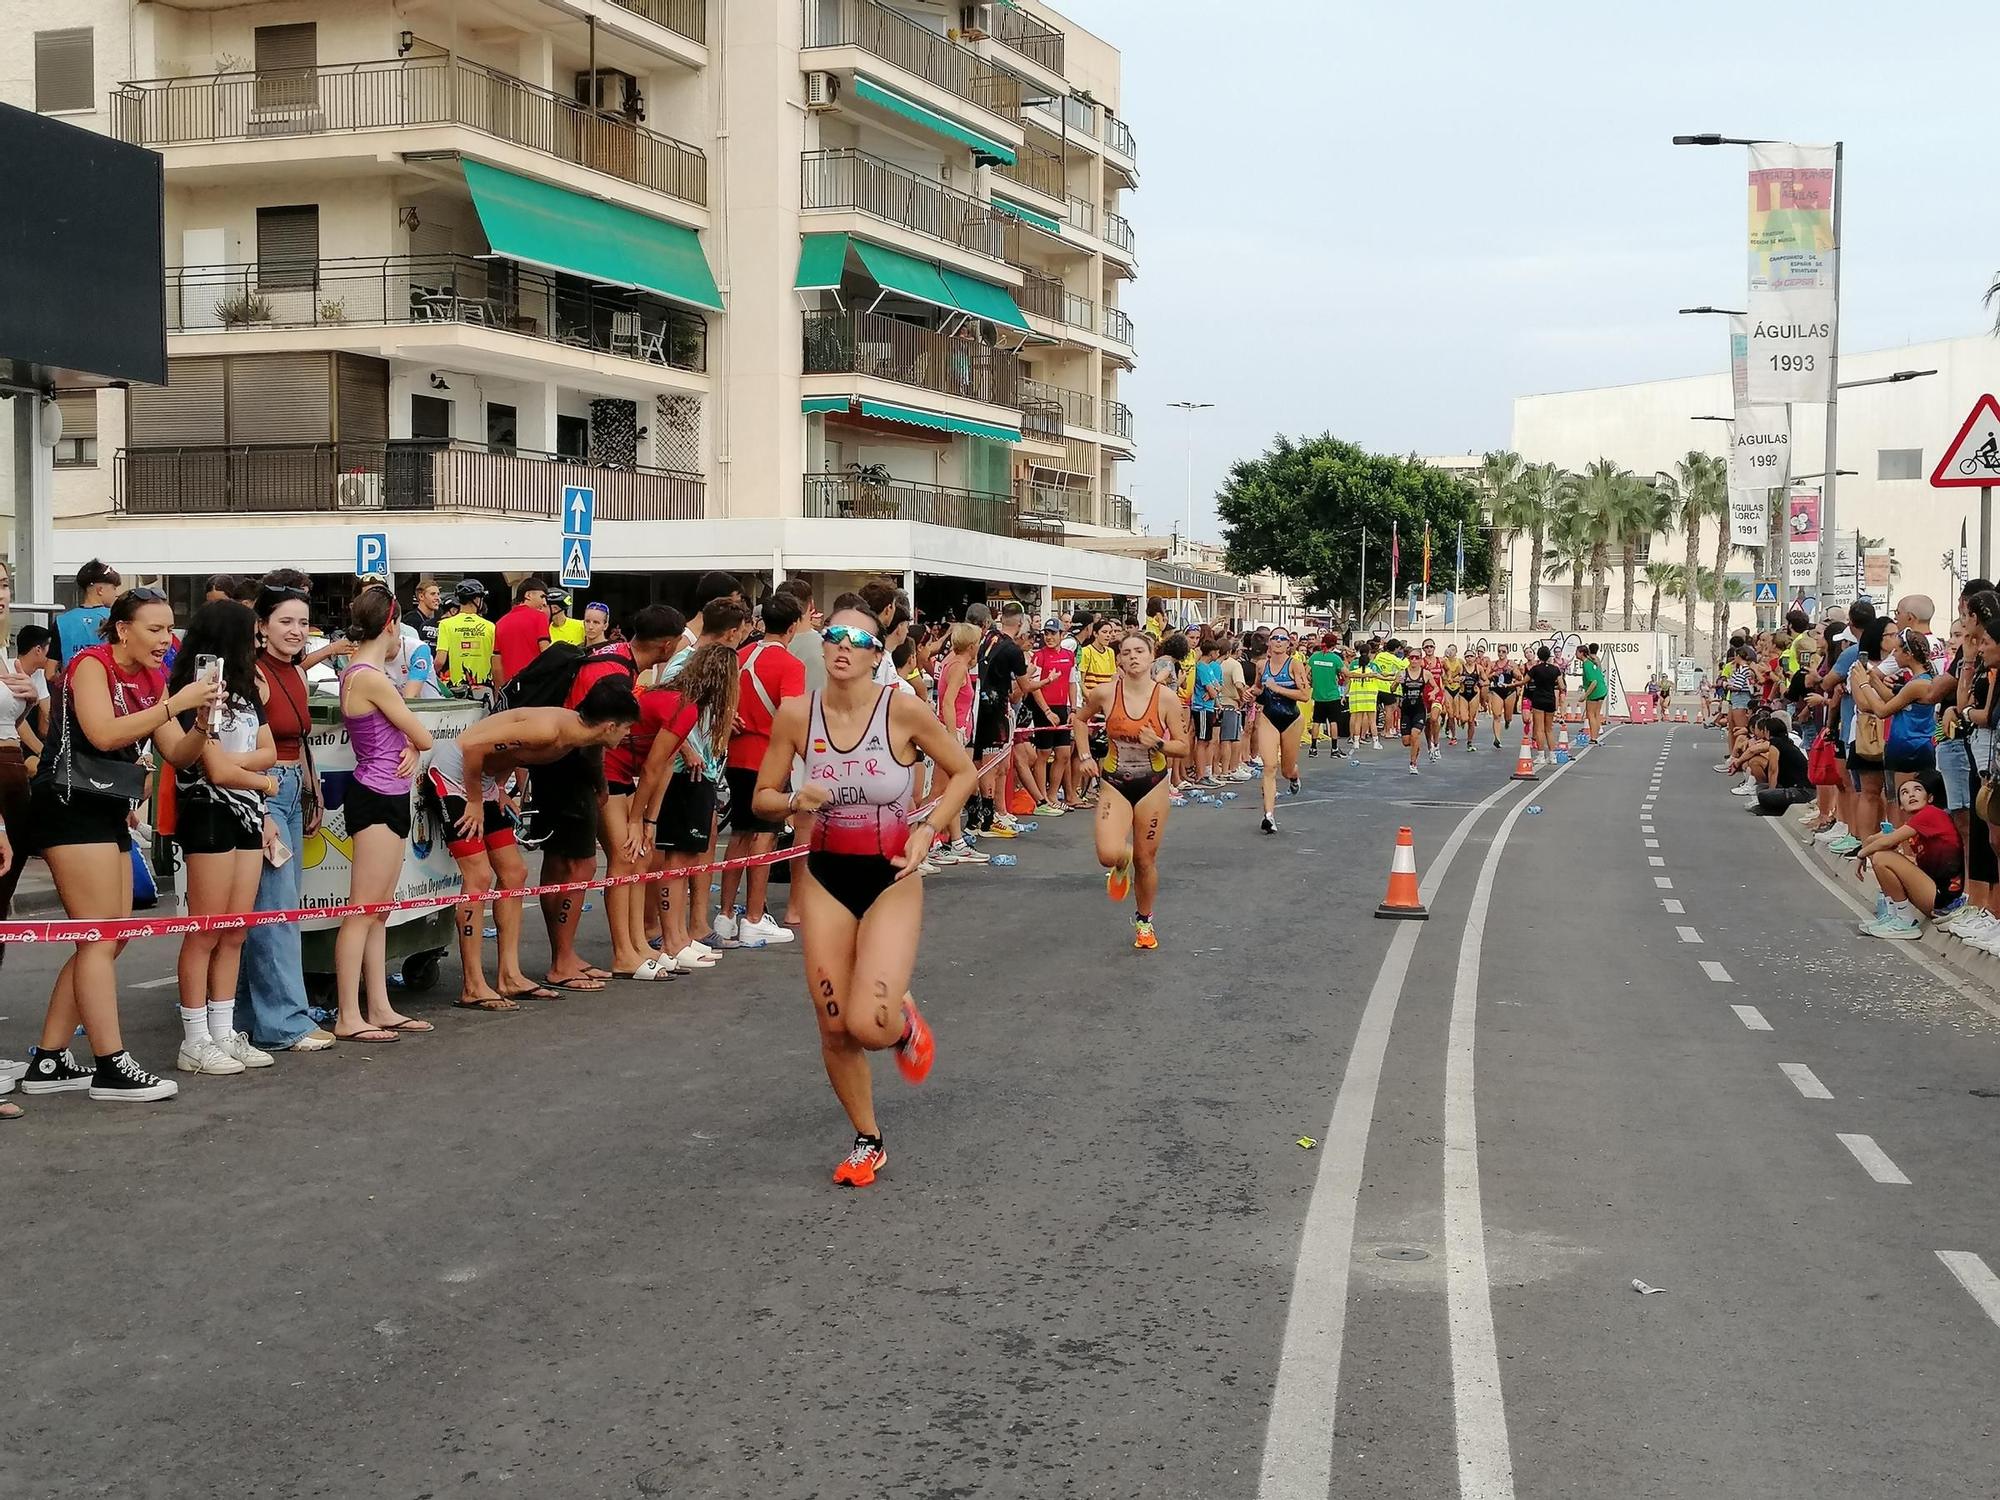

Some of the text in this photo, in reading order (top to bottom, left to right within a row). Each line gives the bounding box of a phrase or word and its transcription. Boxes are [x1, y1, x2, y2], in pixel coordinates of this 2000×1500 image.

[1753, 321, 1829, 339] ÁGUILAS
[1769, 354, 1815, 372] 1993
[1737, 434, 1788, 447] ÁGUILAS
[1734, 512, 1761, 520] LORCA
[1737, 525, 1758, 535] 1991
[362, 537, 382, 572] P
[1792, 568, 1811, 577] 1990
